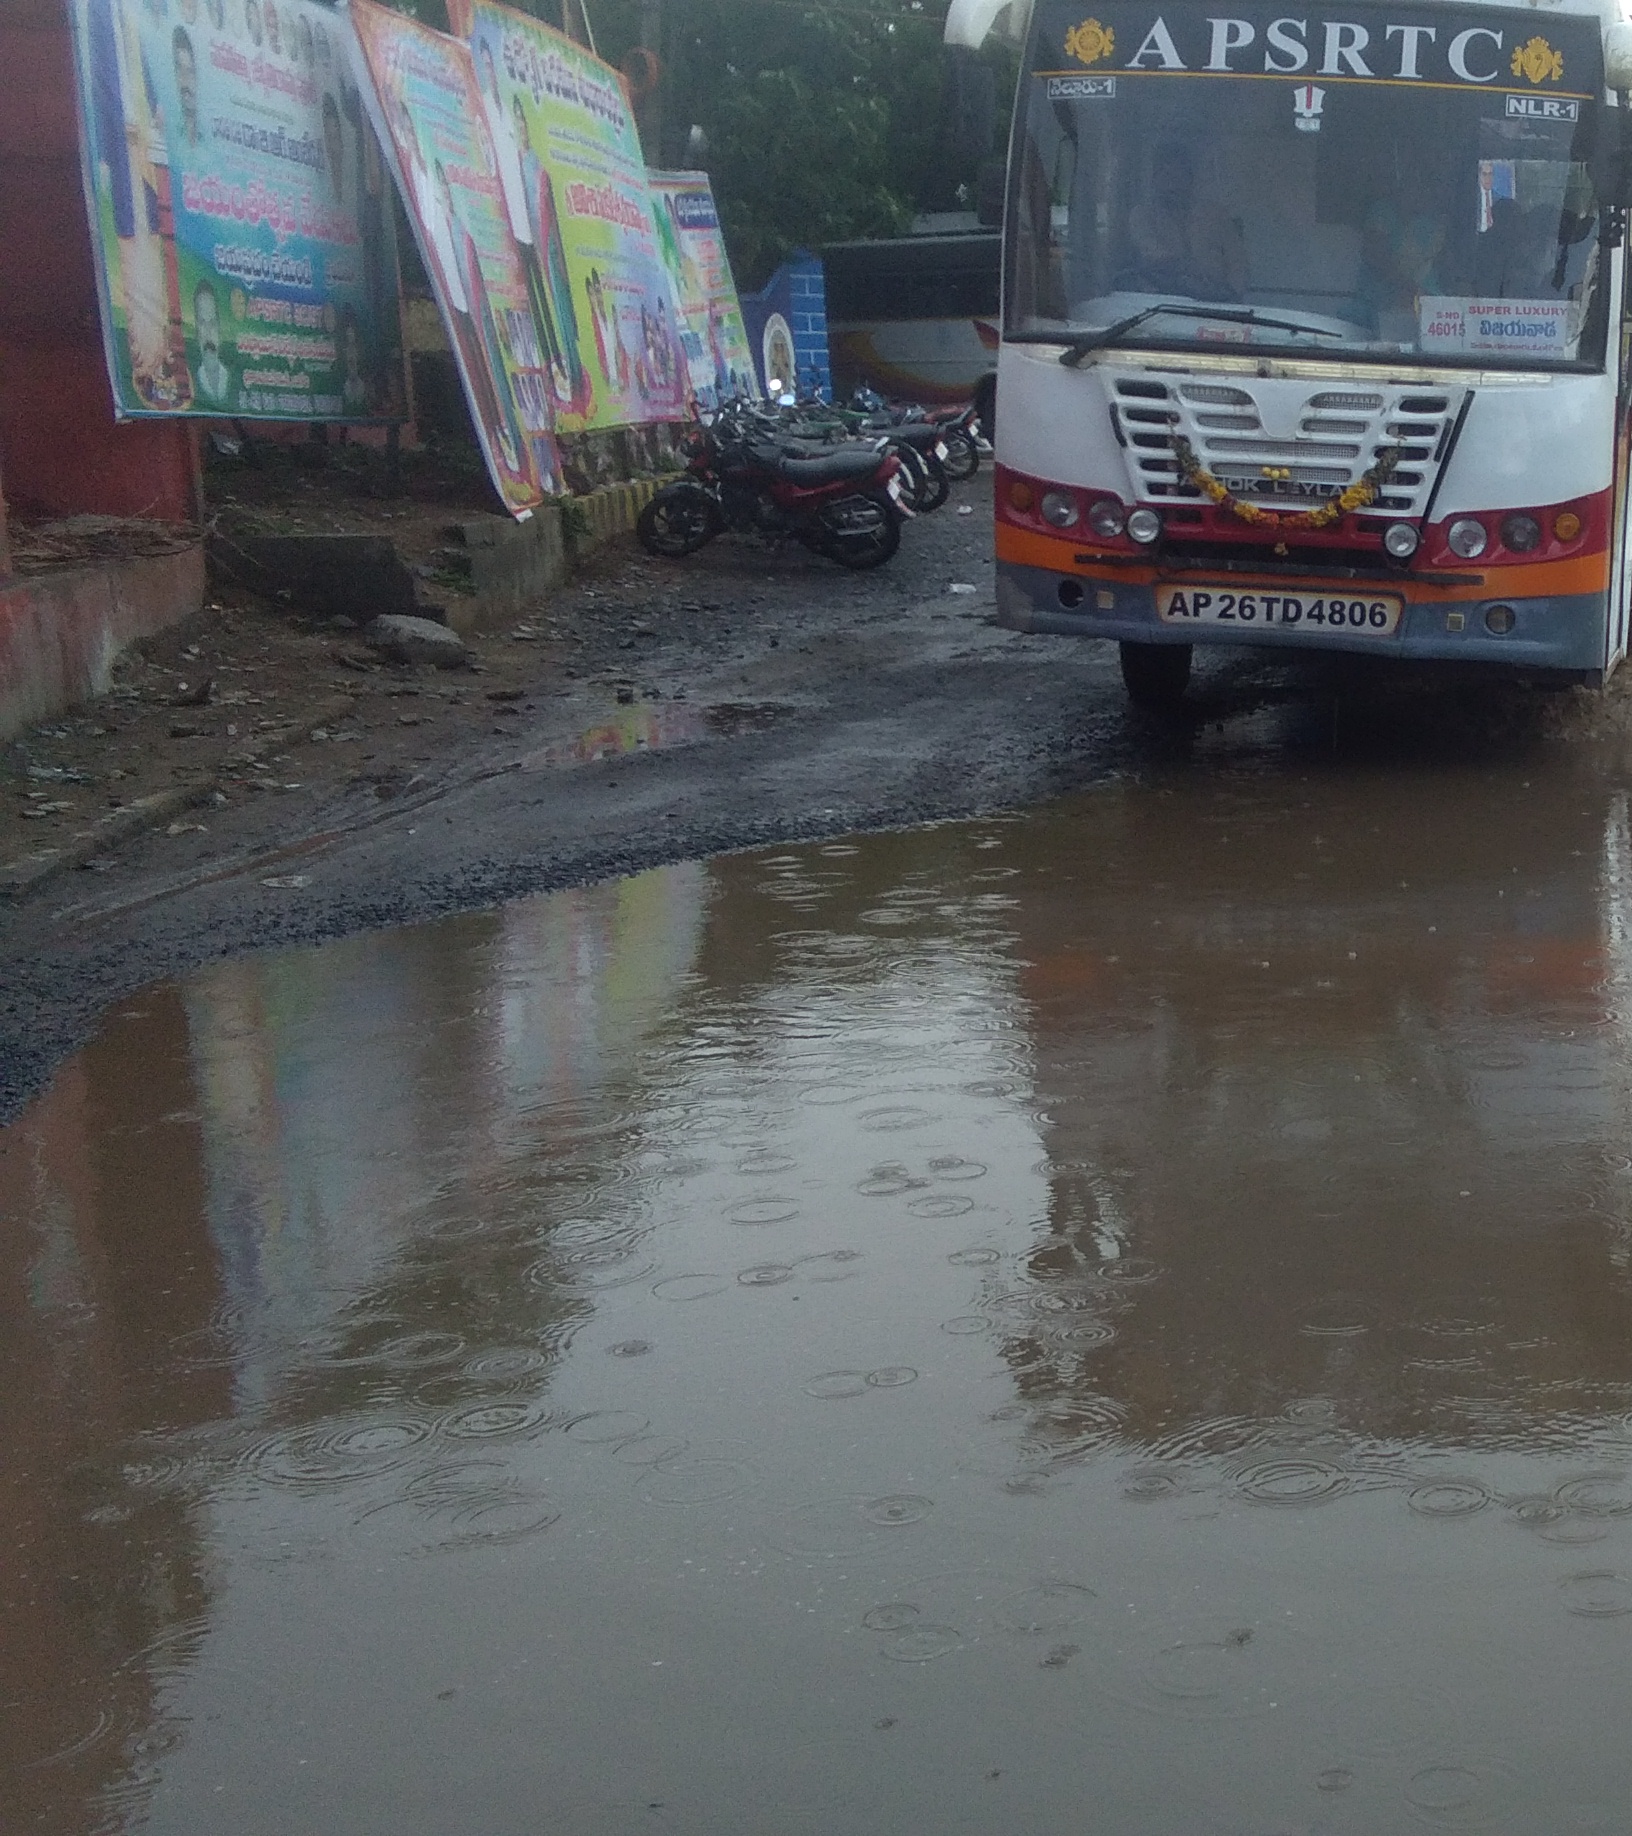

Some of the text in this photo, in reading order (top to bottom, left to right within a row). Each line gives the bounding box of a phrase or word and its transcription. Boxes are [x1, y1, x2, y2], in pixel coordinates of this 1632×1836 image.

[1124, 15, 1504, 82] APSRTC
[1508, 98, 1576, 118] NLR-1
[1468, 305, 1567, 316] SUPER LUXURY
[1427, 321, 1466, 337] 46015
[1479, 319, 1557, 338] విజయవాడ
